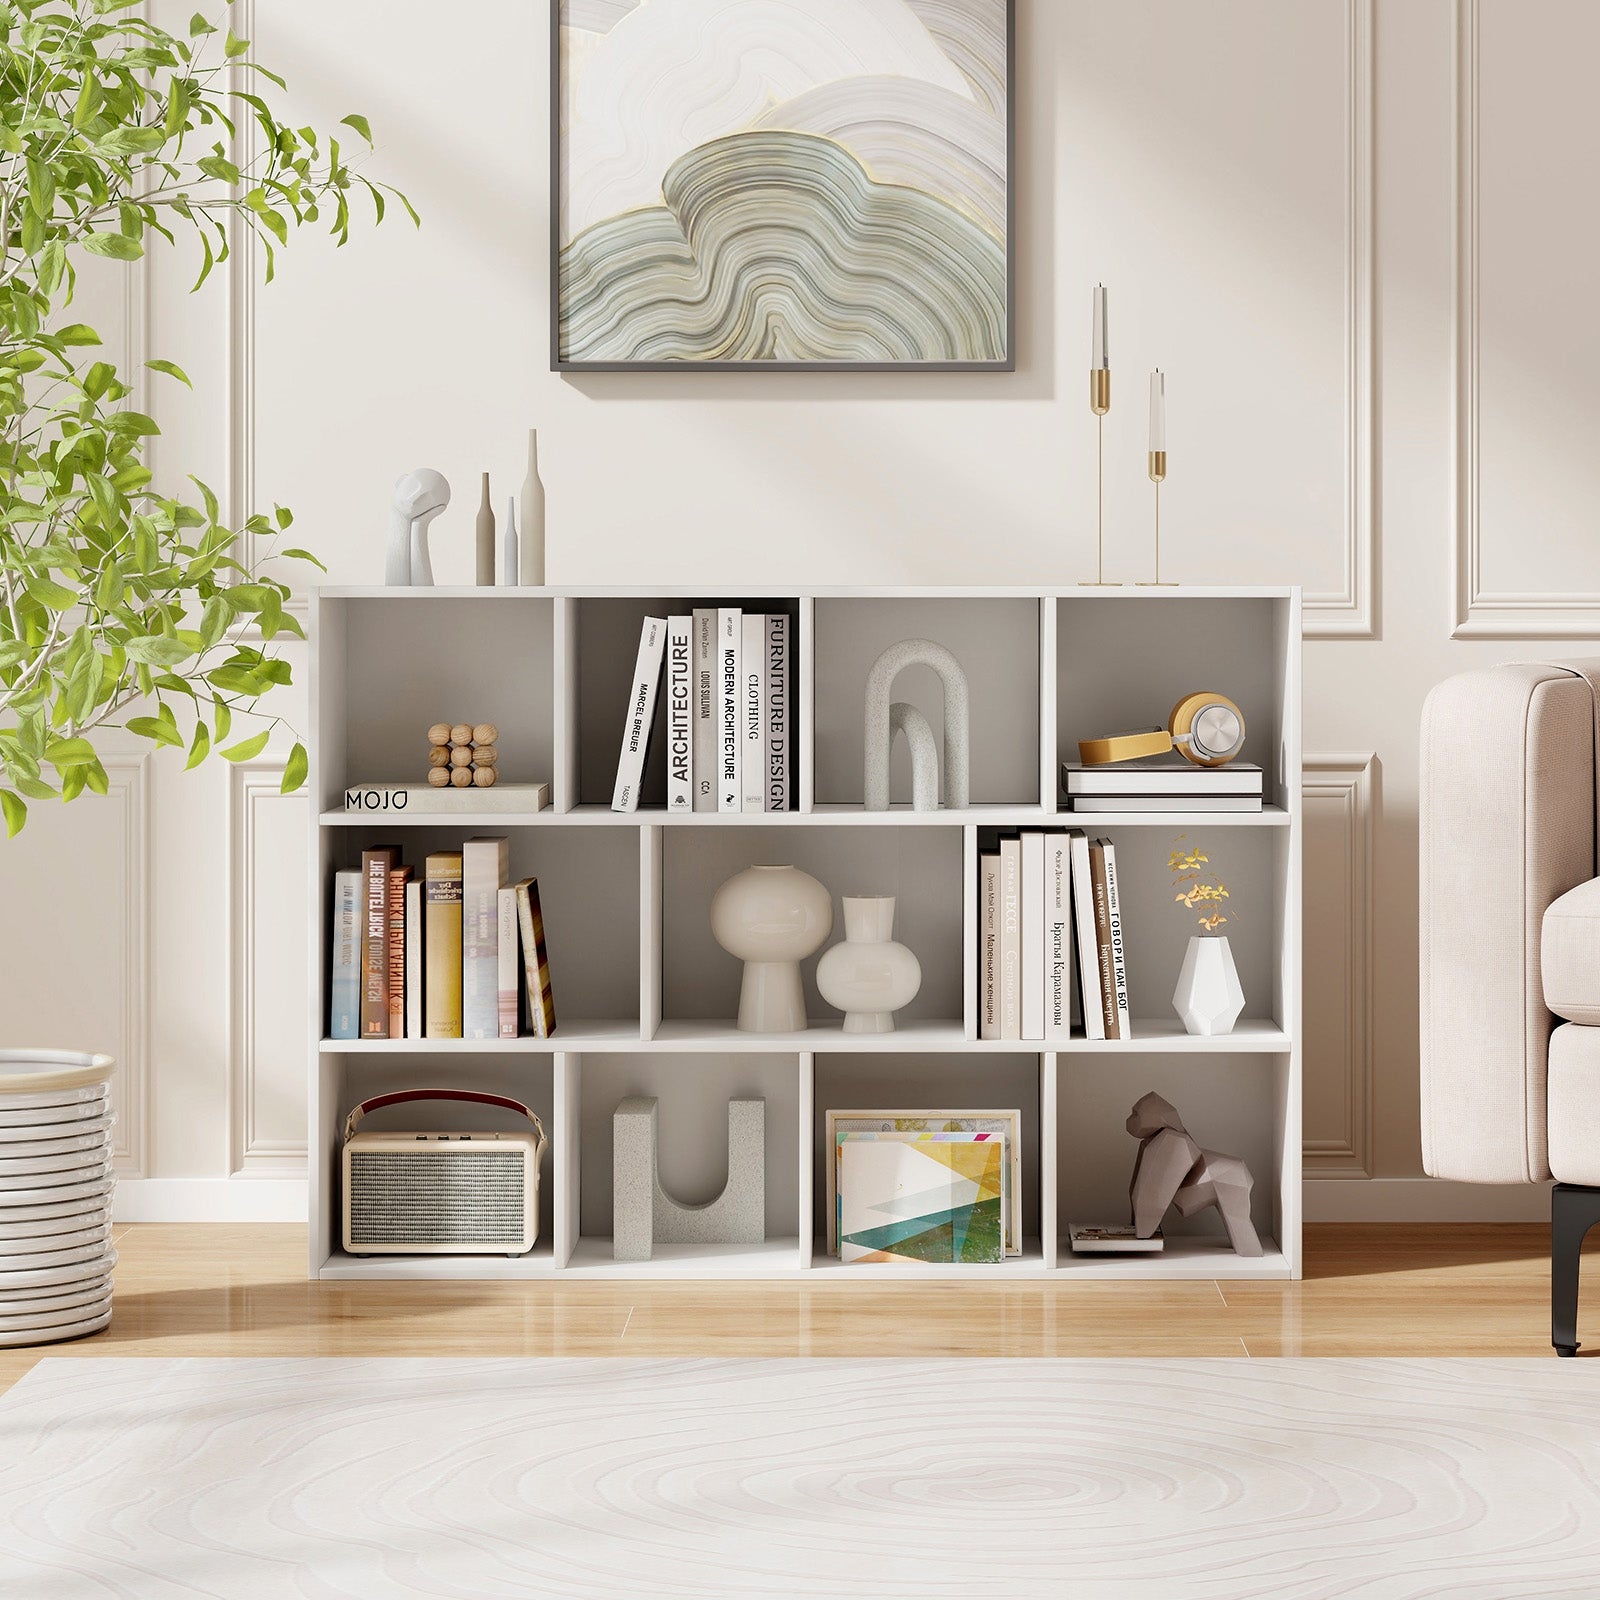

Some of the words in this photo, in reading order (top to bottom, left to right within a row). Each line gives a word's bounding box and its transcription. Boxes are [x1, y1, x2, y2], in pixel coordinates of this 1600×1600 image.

[700, 670, 710, 688] LOUIS
[724, 649, 735, 695] MODERN
[770, 618, 784, 733] FURNITURE
[636, 683, 648, 716] MARCEL
[672, 635, 688, 782] ARCHITECTURE
[700, 690, 710, 719] SULLIVAN
[748, 674, 758, 740] CLOTHING
[629, 719, 642, 753] BREUER
[724, 698, 735, 780] ARCHITECTURE
[770, 739, 784, 811] DESIGN
[346, 791, 408, 810] MOJO
[987, 933, 995, 981] Маленькие
[1050, 922, 1064, 958] Братья
[1111, 913, 1123, 963] ГОВОРИ
[1101, 944, 1112, 992] Бархатная
[1115, 967, 1126, 987] КАК
[986, 983, 995, 1024] женщины
[1050, 961, 1064, 1026] Карамазовы
[1103, 994, 1115, 1026] смерть
[1118, 992, 1128, 1011] БОГ
